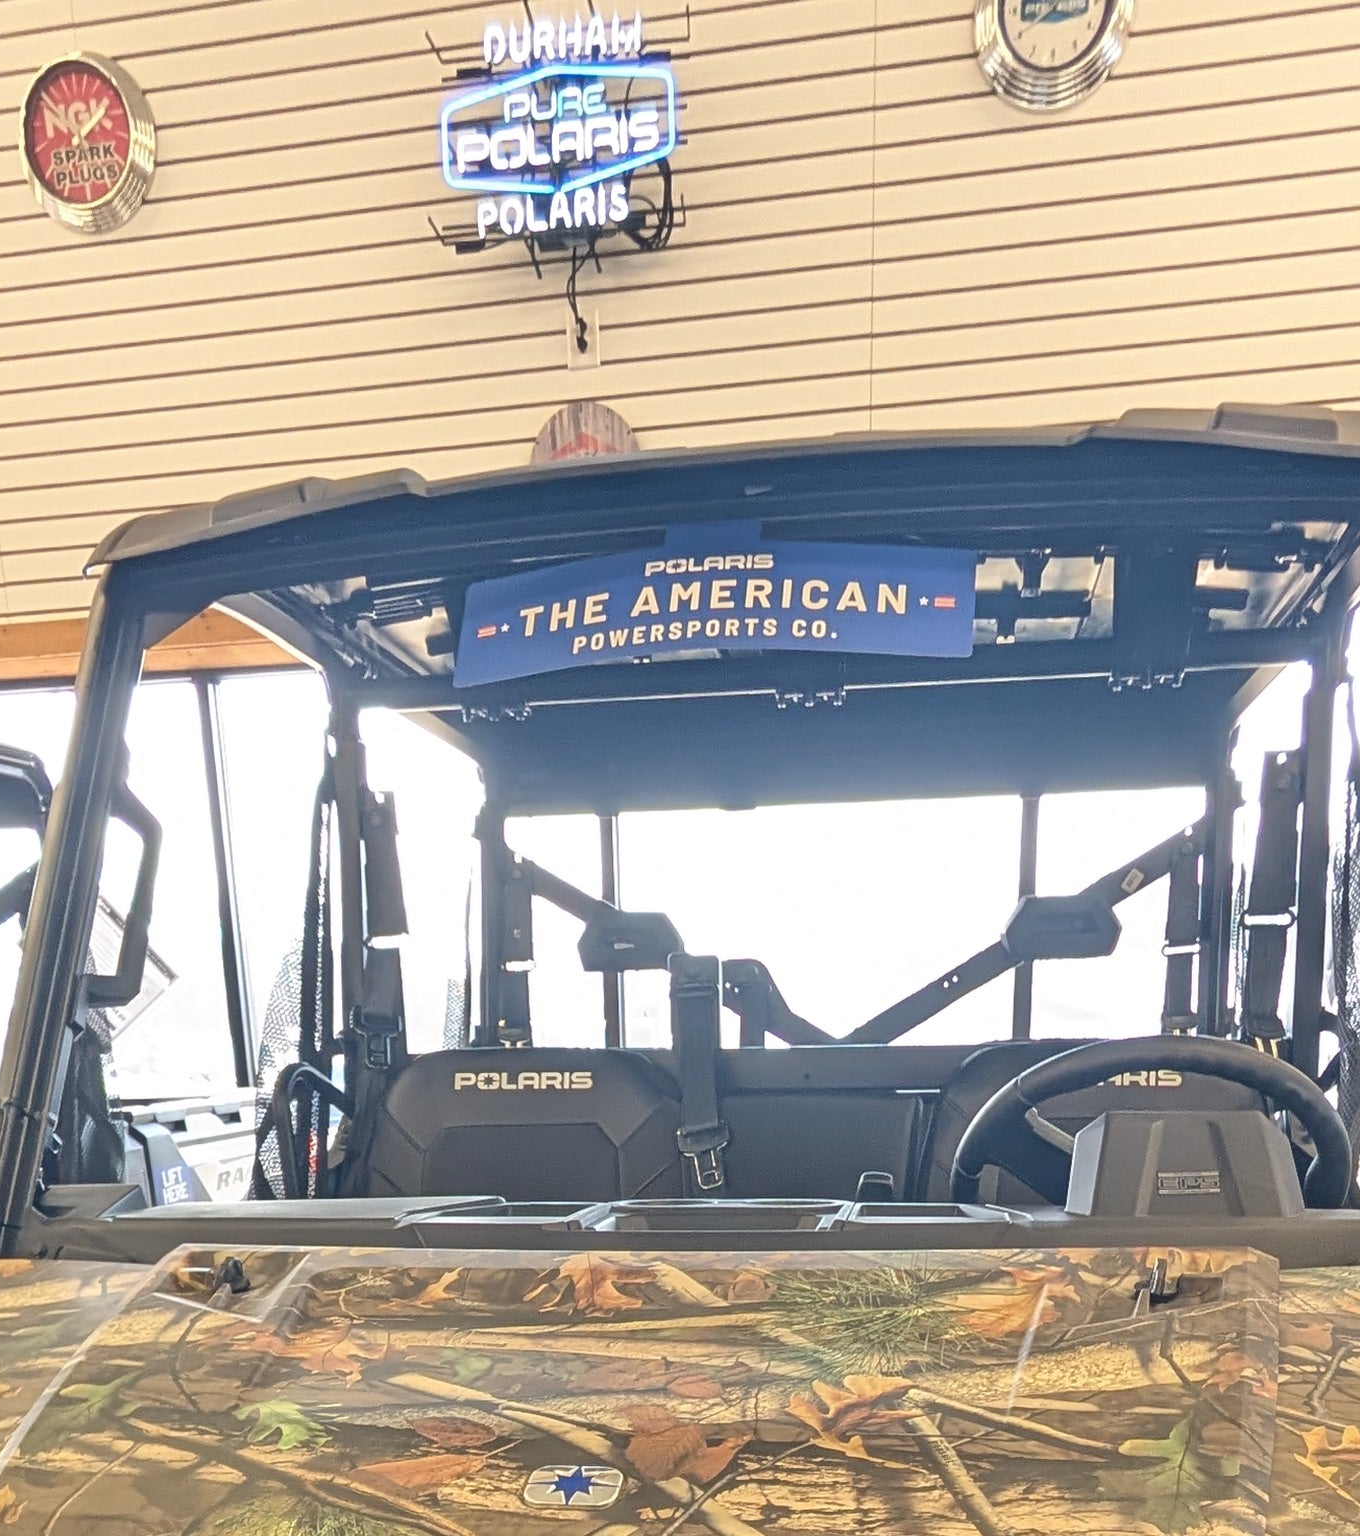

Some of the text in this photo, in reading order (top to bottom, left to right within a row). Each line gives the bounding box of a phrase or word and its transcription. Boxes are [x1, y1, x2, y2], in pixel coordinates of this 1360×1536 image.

[483, 12, 641, 64] DURHAM
[503, 82, 607, 123] PURE
[52, 144, 114, 166] SPARK
[456, 108, 660, 173] POLARIS
[56, 164, 118, 187] PLUGS
[477, 184, 629, 239] POLARIS
[645, 554, 774, 577] POLARIS
[520, 578, 908, 638] THE AMERICAN
[572, 618, 838, 654] POWERSPORTS CO.
[454, 1071, 593, 1090] POLARIS
[161, 1166, 183, 1187] LIFT
[162, 1182, 189, 1205] HERE
